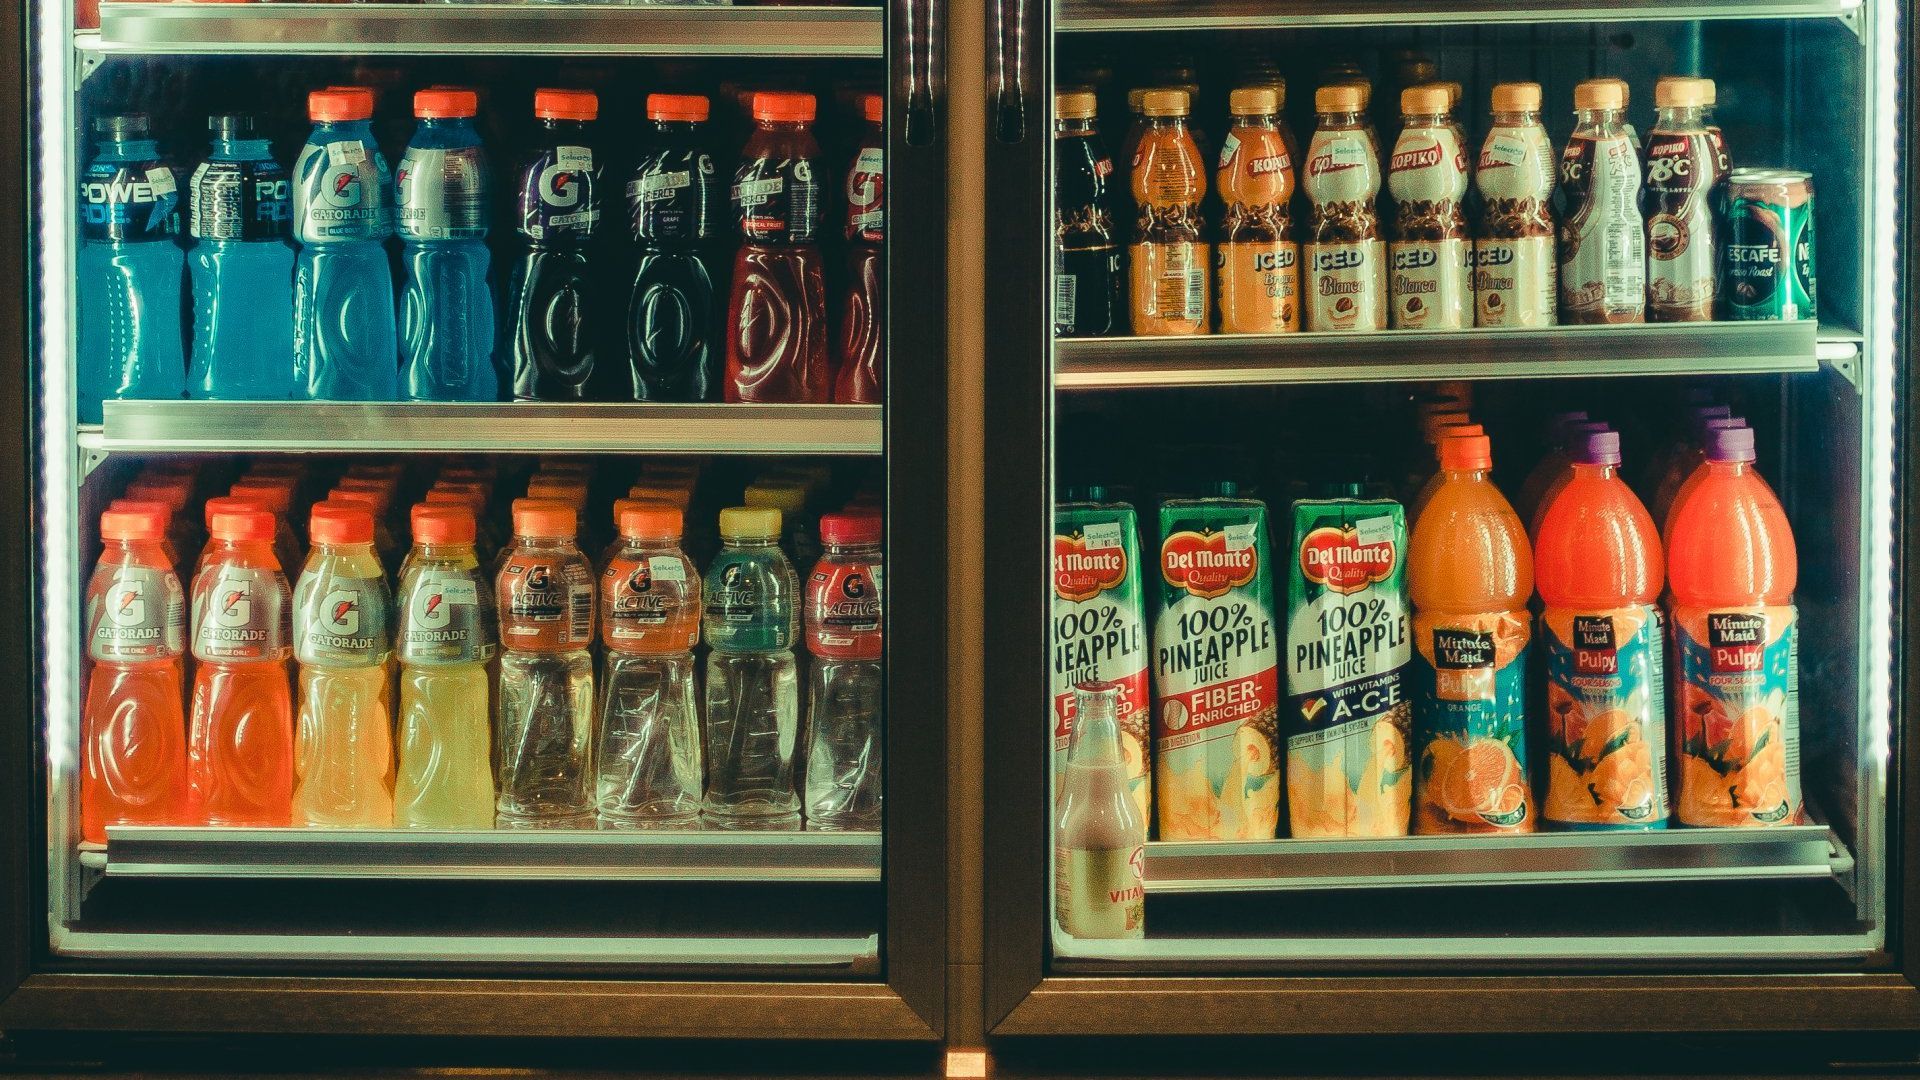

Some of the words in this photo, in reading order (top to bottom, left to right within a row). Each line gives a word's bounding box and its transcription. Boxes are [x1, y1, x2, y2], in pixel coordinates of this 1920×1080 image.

[1653, 142, 1685, 155] KOPIKO
[1390, 150, 1438, 170] KOPIKO
[539, 163, 579, 207] G
[311, 208, 377, 220] GATORADE
[1254, 250, 1295, 272] ICED
[1314, 250, 1364, 272] ICED
[1749, 266, 1774, 277] Roast
[1319, 275, 1365, 295] Blanca
[1395, 274, 1437, 294] Blanca
[1067, 553, 1121, 571] Monte
[1167, 551, 1194, 569] Del
[1197, 550, 1251, 567] Monte
[1307, 548, 1334, 565] Del
[1336, 547, 1390, 564] Monte
[1059, 573, 1098, 588] Quality
[1188, 570, 1229, 584] Quality
[1328, 566, 1367, 581] Quality
[106, 580, 146, 627] G
[210, 580, 251, 628] G
[514, 591, 562, 607] ACTIVE
[615, 594, 667, 611] ACTIVE
[710, 590, 754, 606] ACTIVE
[319, 589, 360, 636] G
[828, 601, 877, 616] ACTIVE
[1317, 598, 1391, 637] 100%
[1177, 603, 1253, 641] 100%
[1578, 620, 1611, 633] Minute
[1713, 616, 1762, 631] Minute
[98, 627, 161, 640] GATORADE
[201, 627, 267, 641] GATORADE
[309, 635, 375, 649] GATORADE
[404, 629, 468, 643] GATORADE
[1583, 632, 1608, 645] Maid
[1720, 629, 1757, 643] Maid
[1055, 622, 1141, 675] NEAPPLE
[1160, 620, 1270, 677] PINEAPPLE
[1296, 615, 1405, 674] PINEAPPLE
[1438, 636, 1491, 652] Minute
[1446, 650, 1484, 665] Maid
[1579, 651, 1617, 673] Pulpy
[1717, 649, 1762, 670] Pulpy
[1065, 663, 1099, 689] JUICE
[1193, 661, 1229, 685] JUICE
[1332, 657, 1366, 682] JUICE
[1332, 686, 1356, 699] WITH
[1358, 674, 1400, 692] VITAMINS
[1710, 677, 1733, 687] FOUR
[1191, 680, 1263, 713] FIBER-
[1332, 684, 1401, 722] A-C-E
[1192, 698, 1262, 727] ENRICHED
[1447, 703, 1482, 712] ORANGE
[1170, 733, 1201, 747] DIGESTION
